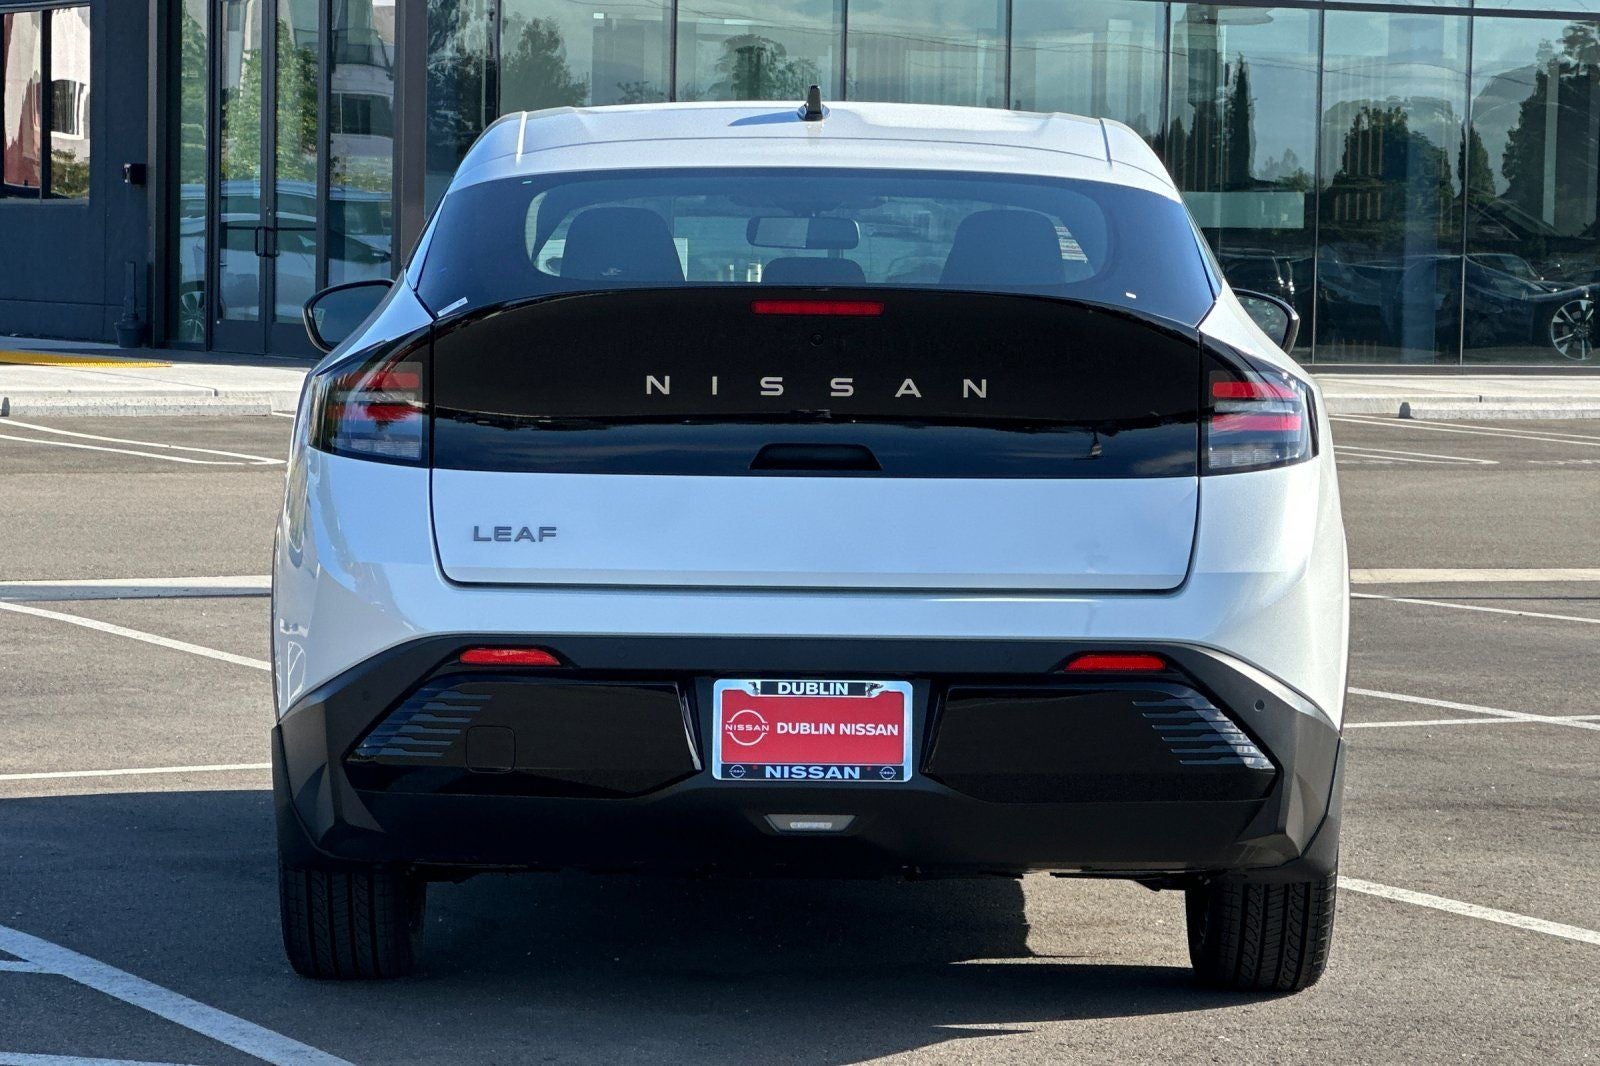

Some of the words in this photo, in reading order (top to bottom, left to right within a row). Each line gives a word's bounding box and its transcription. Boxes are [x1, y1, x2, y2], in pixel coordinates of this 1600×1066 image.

[646, 375, 987, 399] NISSAN
[473, 525, 557, 542] LEAF
[777, 682, 849, 696] DUBLIN
[725, 723, 769, 732] NISSAN
[776, 722, 835, 735] DUBLIN
[839, 723, 899, 736] NISSAN
[765, 765, 860, 779] NISSAN
